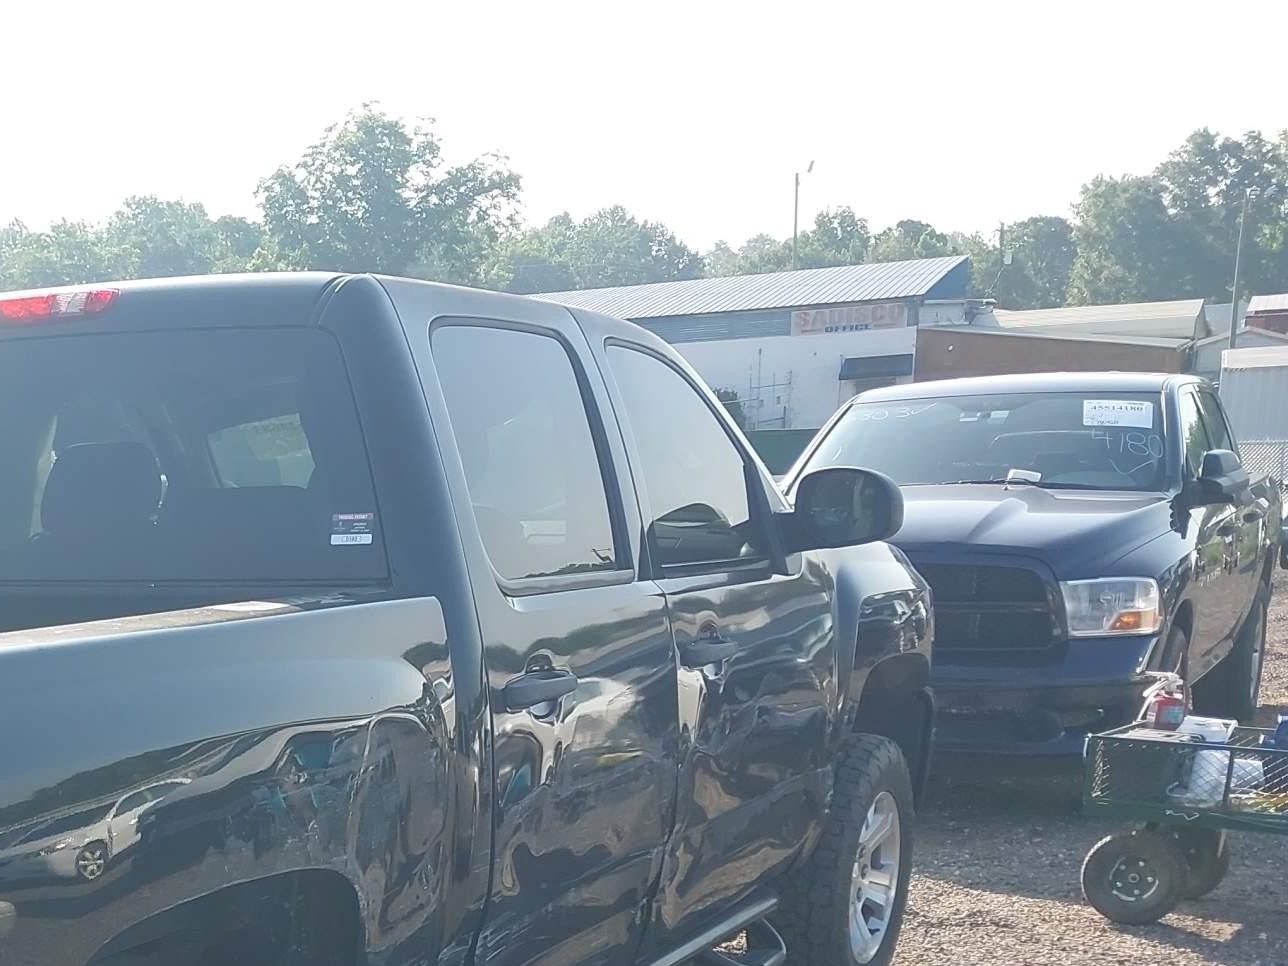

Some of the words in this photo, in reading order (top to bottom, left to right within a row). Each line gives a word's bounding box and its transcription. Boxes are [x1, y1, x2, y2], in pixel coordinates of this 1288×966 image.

[795, 303, 904, 328] SADISCO
[824, 323, 873, 333] OFFICE
[1091, 428, 1164, 458] 4180
